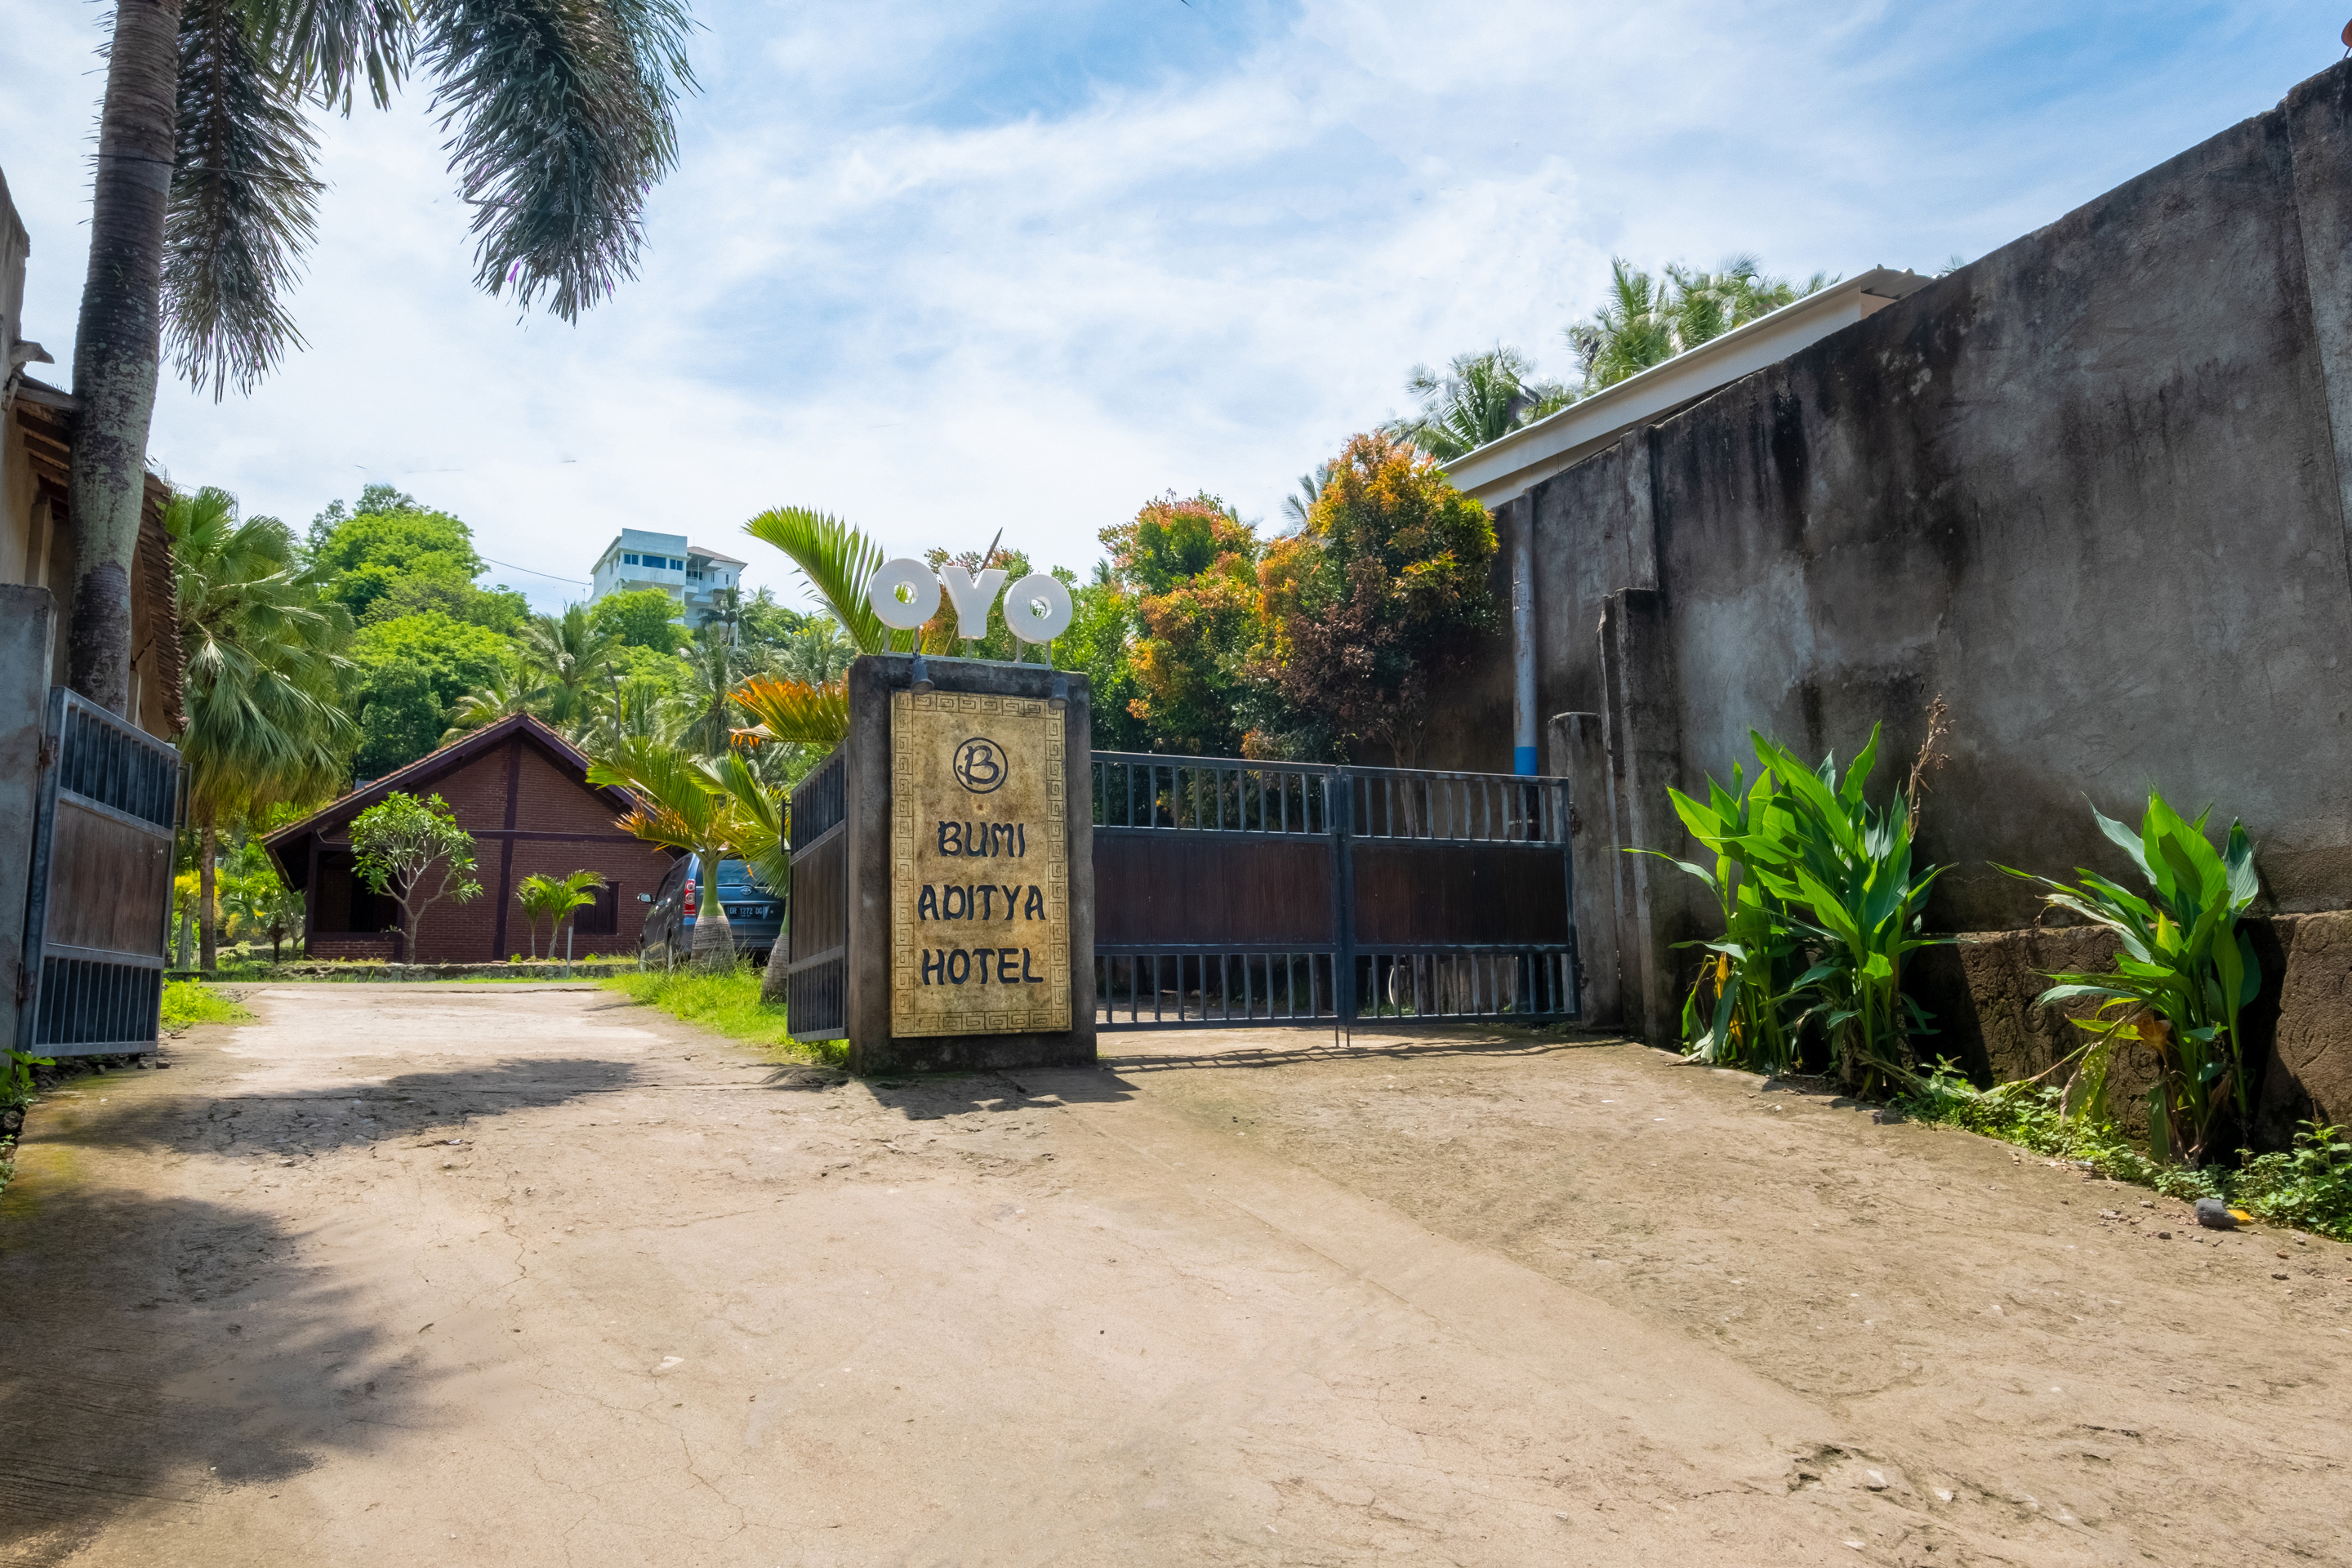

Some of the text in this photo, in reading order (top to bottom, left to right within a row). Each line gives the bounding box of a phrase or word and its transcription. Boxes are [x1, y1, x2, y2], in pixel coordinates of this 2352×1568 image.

[869, 558, 1073, 644] OYO
[938, 821, 1026, 858] BUMI
[917, 884, 1046, 920] ADITYA
[921, 947, 1044, 985] HOTEL
